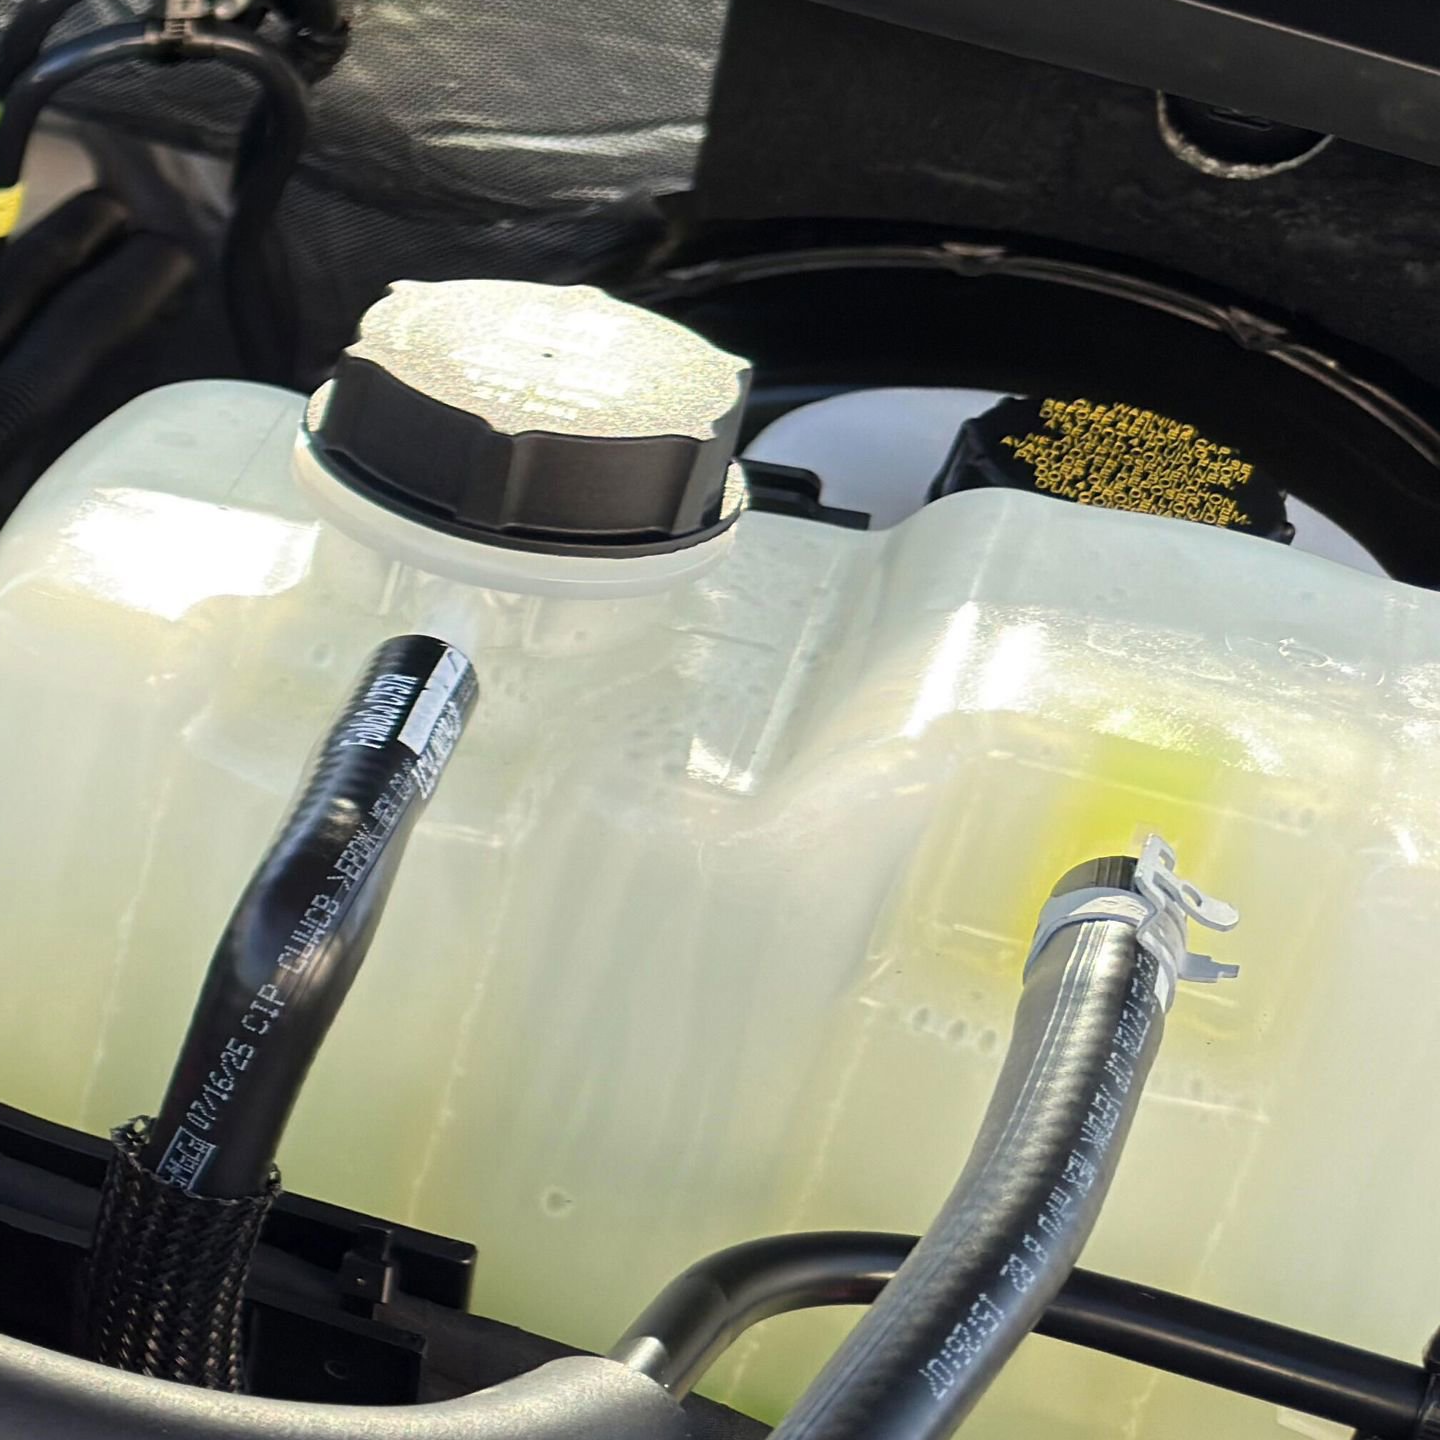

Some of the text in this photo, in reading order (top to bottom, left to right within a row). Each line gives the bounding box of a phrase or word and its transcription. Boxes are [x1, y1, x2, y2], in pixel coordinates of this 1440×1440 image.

[1215, 454, 1254, 475] USE
[186, 1037, 254, 1130] 07/16/25
[241, 983, 286, 1035] CIP
[920, 1293, 1006, 1400] 15:26:07
